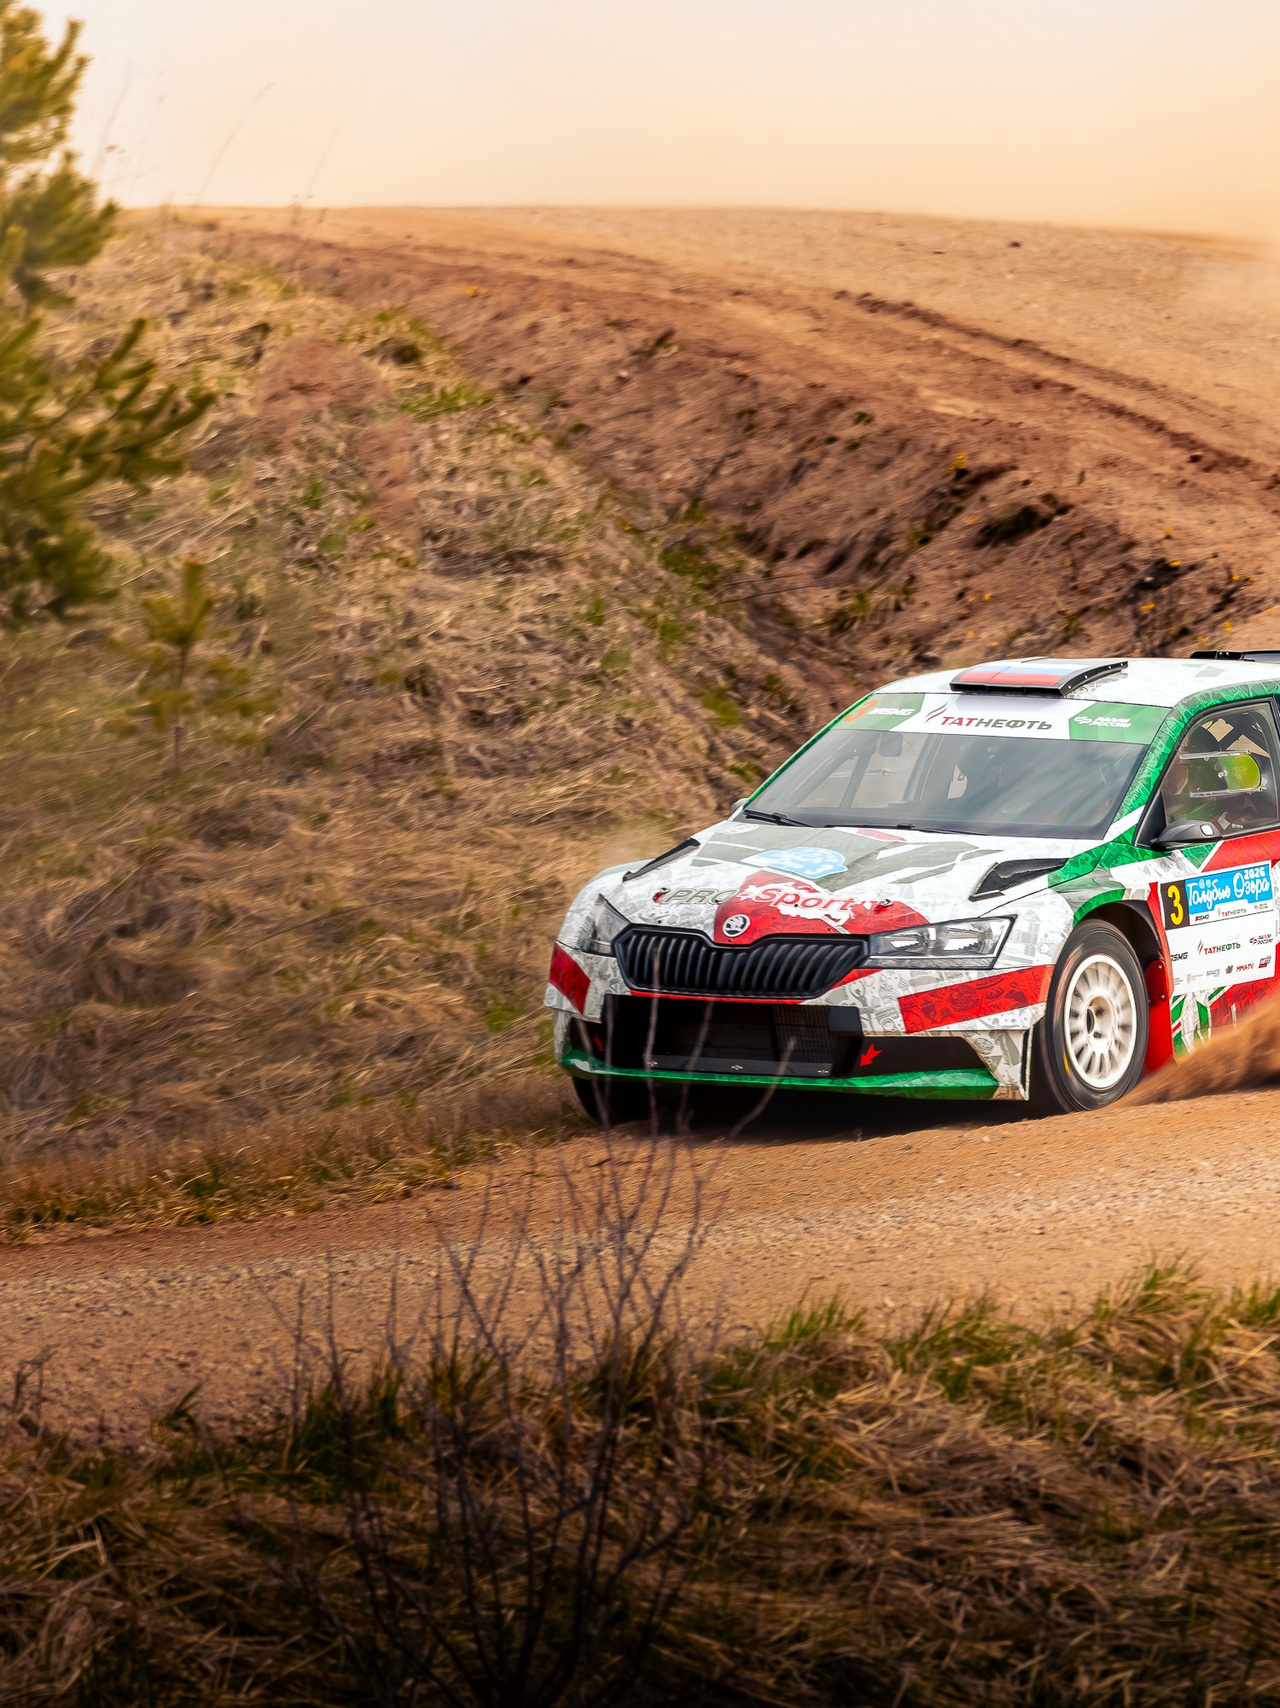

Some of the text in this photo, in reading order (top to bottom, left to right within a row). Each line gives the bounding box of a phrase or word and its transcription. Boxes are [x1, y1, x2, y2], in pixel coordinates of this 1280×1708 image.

[843, 700, 878, 722] 3
[941, 716, 1053, 730] ТАТНЕФТЬ
[1167, 885, 1184, 925] 3
[1221, 908, 1247, 917] ТАТНЕФТЬ
[1204, 942, 1241, 955] ТАТНЕФТЬ
